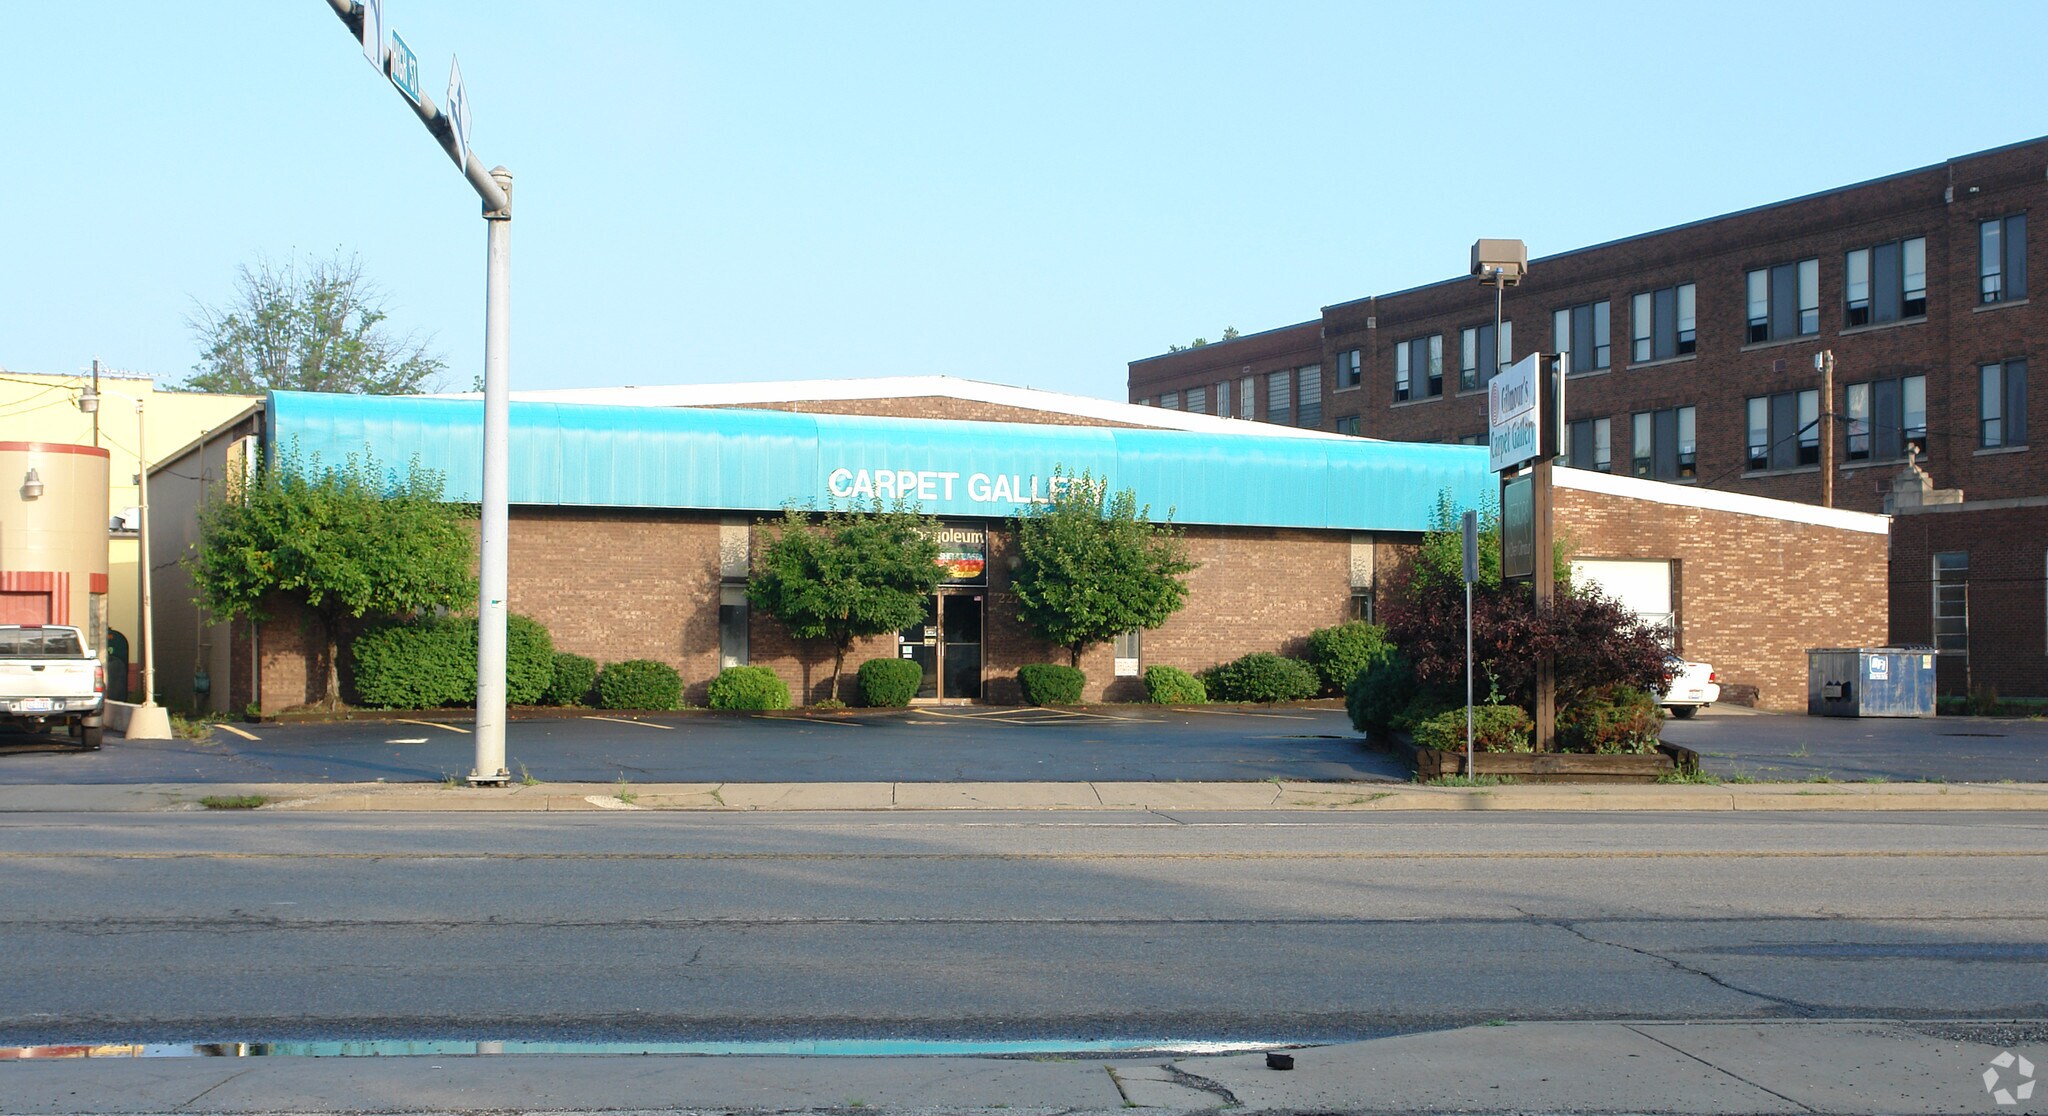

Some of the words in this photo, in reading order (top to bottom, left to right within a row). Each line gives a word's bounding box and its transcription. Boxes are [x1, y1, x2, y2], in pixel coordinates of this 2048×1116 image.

[1501, 376, 1529, 414] Gilmour's
[1491, 425, 1511, 463] Carpet
[1511, 417, 1535, 452] Gallery
[828, 467, 960, 501] CARPET
